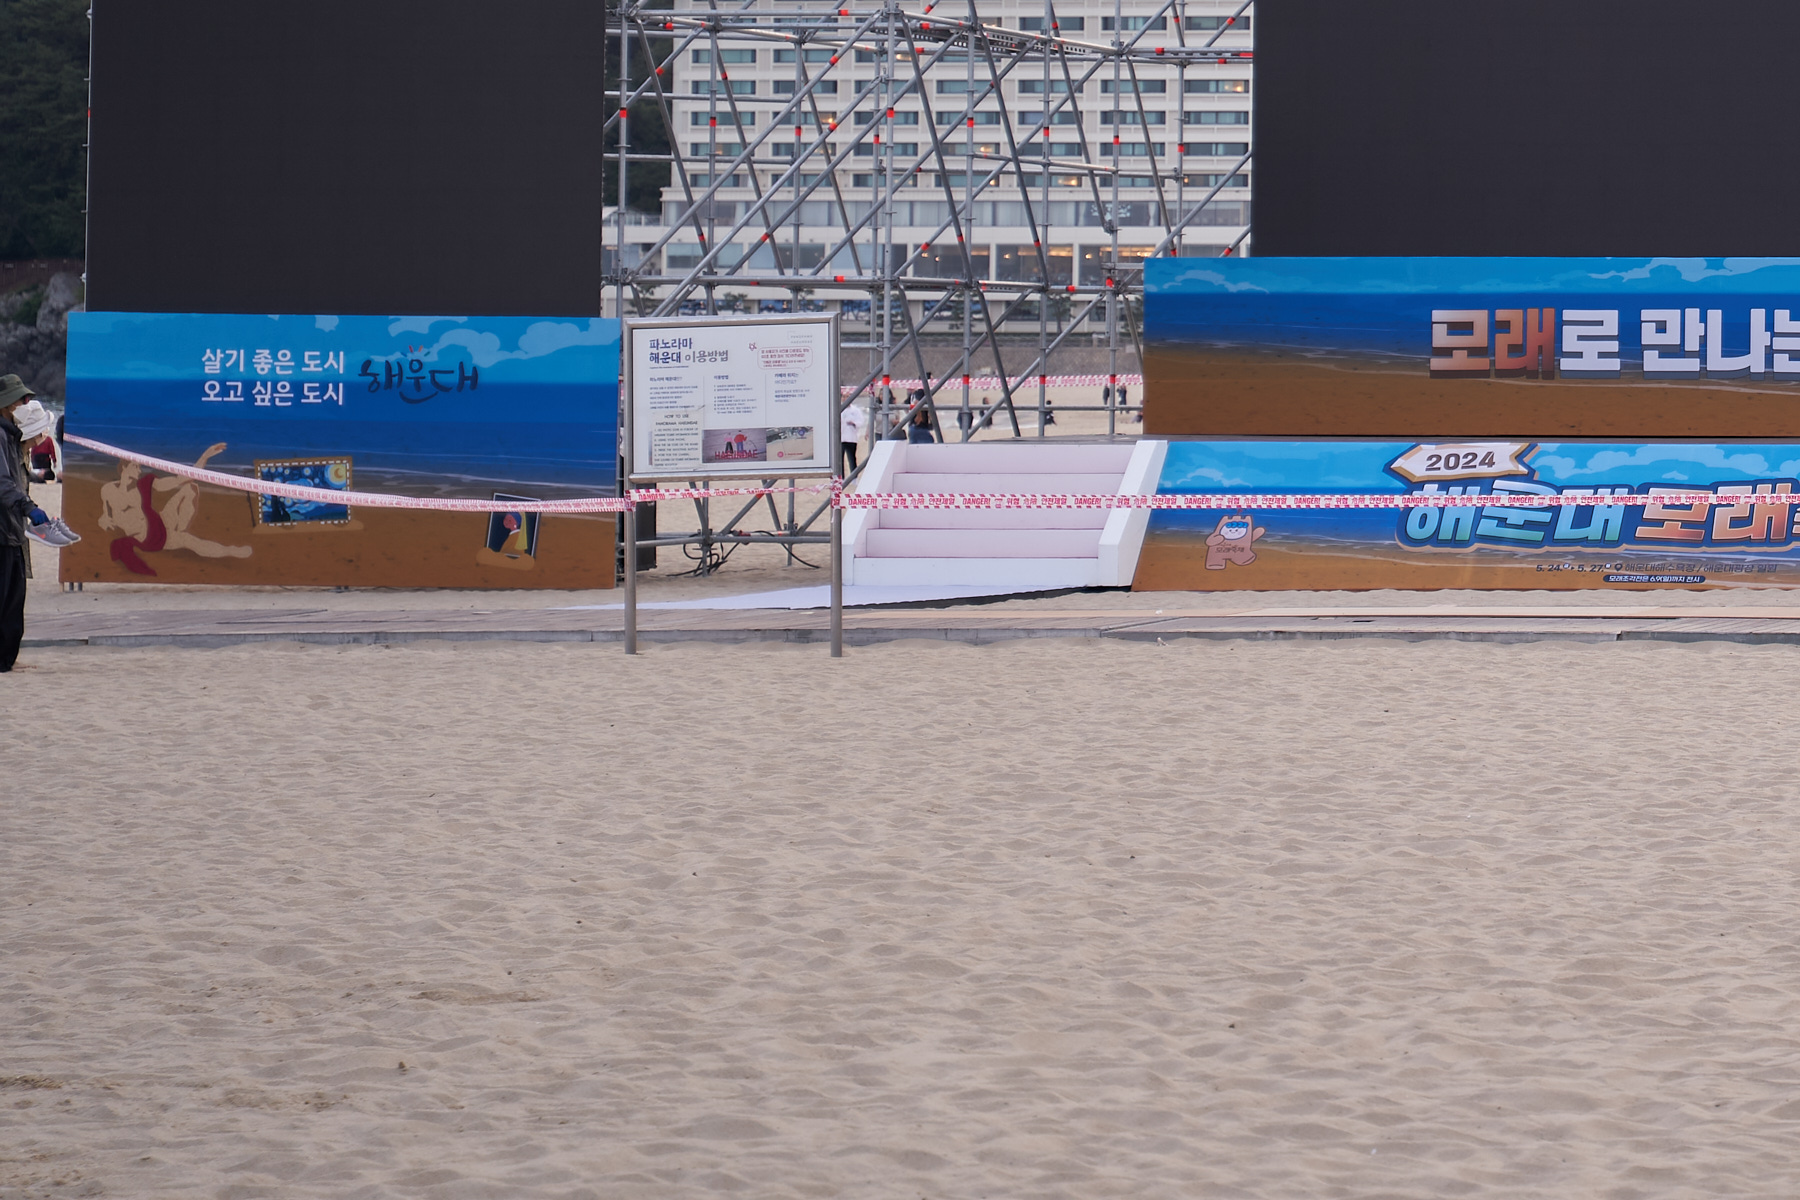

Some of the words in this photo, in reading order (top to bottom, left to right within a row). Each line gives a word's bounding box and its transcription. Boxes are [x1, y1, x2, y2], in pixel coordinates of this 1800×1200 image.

[649, 337, 693, 350] 파노라마
[1430, 308, 1620, 376] 모래로
[649, 351, 681, 364] 해운대
[684, 349, 729, 363] 이용방법
[201, 348, 245, 373] 살기
[252, 349, 295, 375] 좋은
[301, 350, 345, 374] 도시
[358, 358, 479, 405] 해운대
[201, 380, 245, 402] 오고
[252, 380, 295, 406] 싶은
[300, 381, 344, 406] 도시
[1425, 450, 1496, 472] 2024
[848, 498, 877, 506] DANGER!
[962, 498, 991, 506] DANGER!
[1074, 498, 1101, 506] DANGER!
[1184, 498, 1211, 506] DANGER!
[1294, 497, 1321, 505] DANGER!
[1402, 497, 1429, 505] DANGER!
[1508, 496, 1534, 504] DANGER!
[1716, 495, 1741, 503] DANGER!
[1405, 479, 1629, 543] 해운대
[1536, 564, 1545, 572] 5.
[1547, 564, 1563, 572] 24.
[1577, 564, 1587, 572] 5.
[1589, 564, 1604, 572] 27.
[1625, 562, 1696, 573] 해운대해수욕장
[1608, 575, 1649, 583] 모래조각전은
